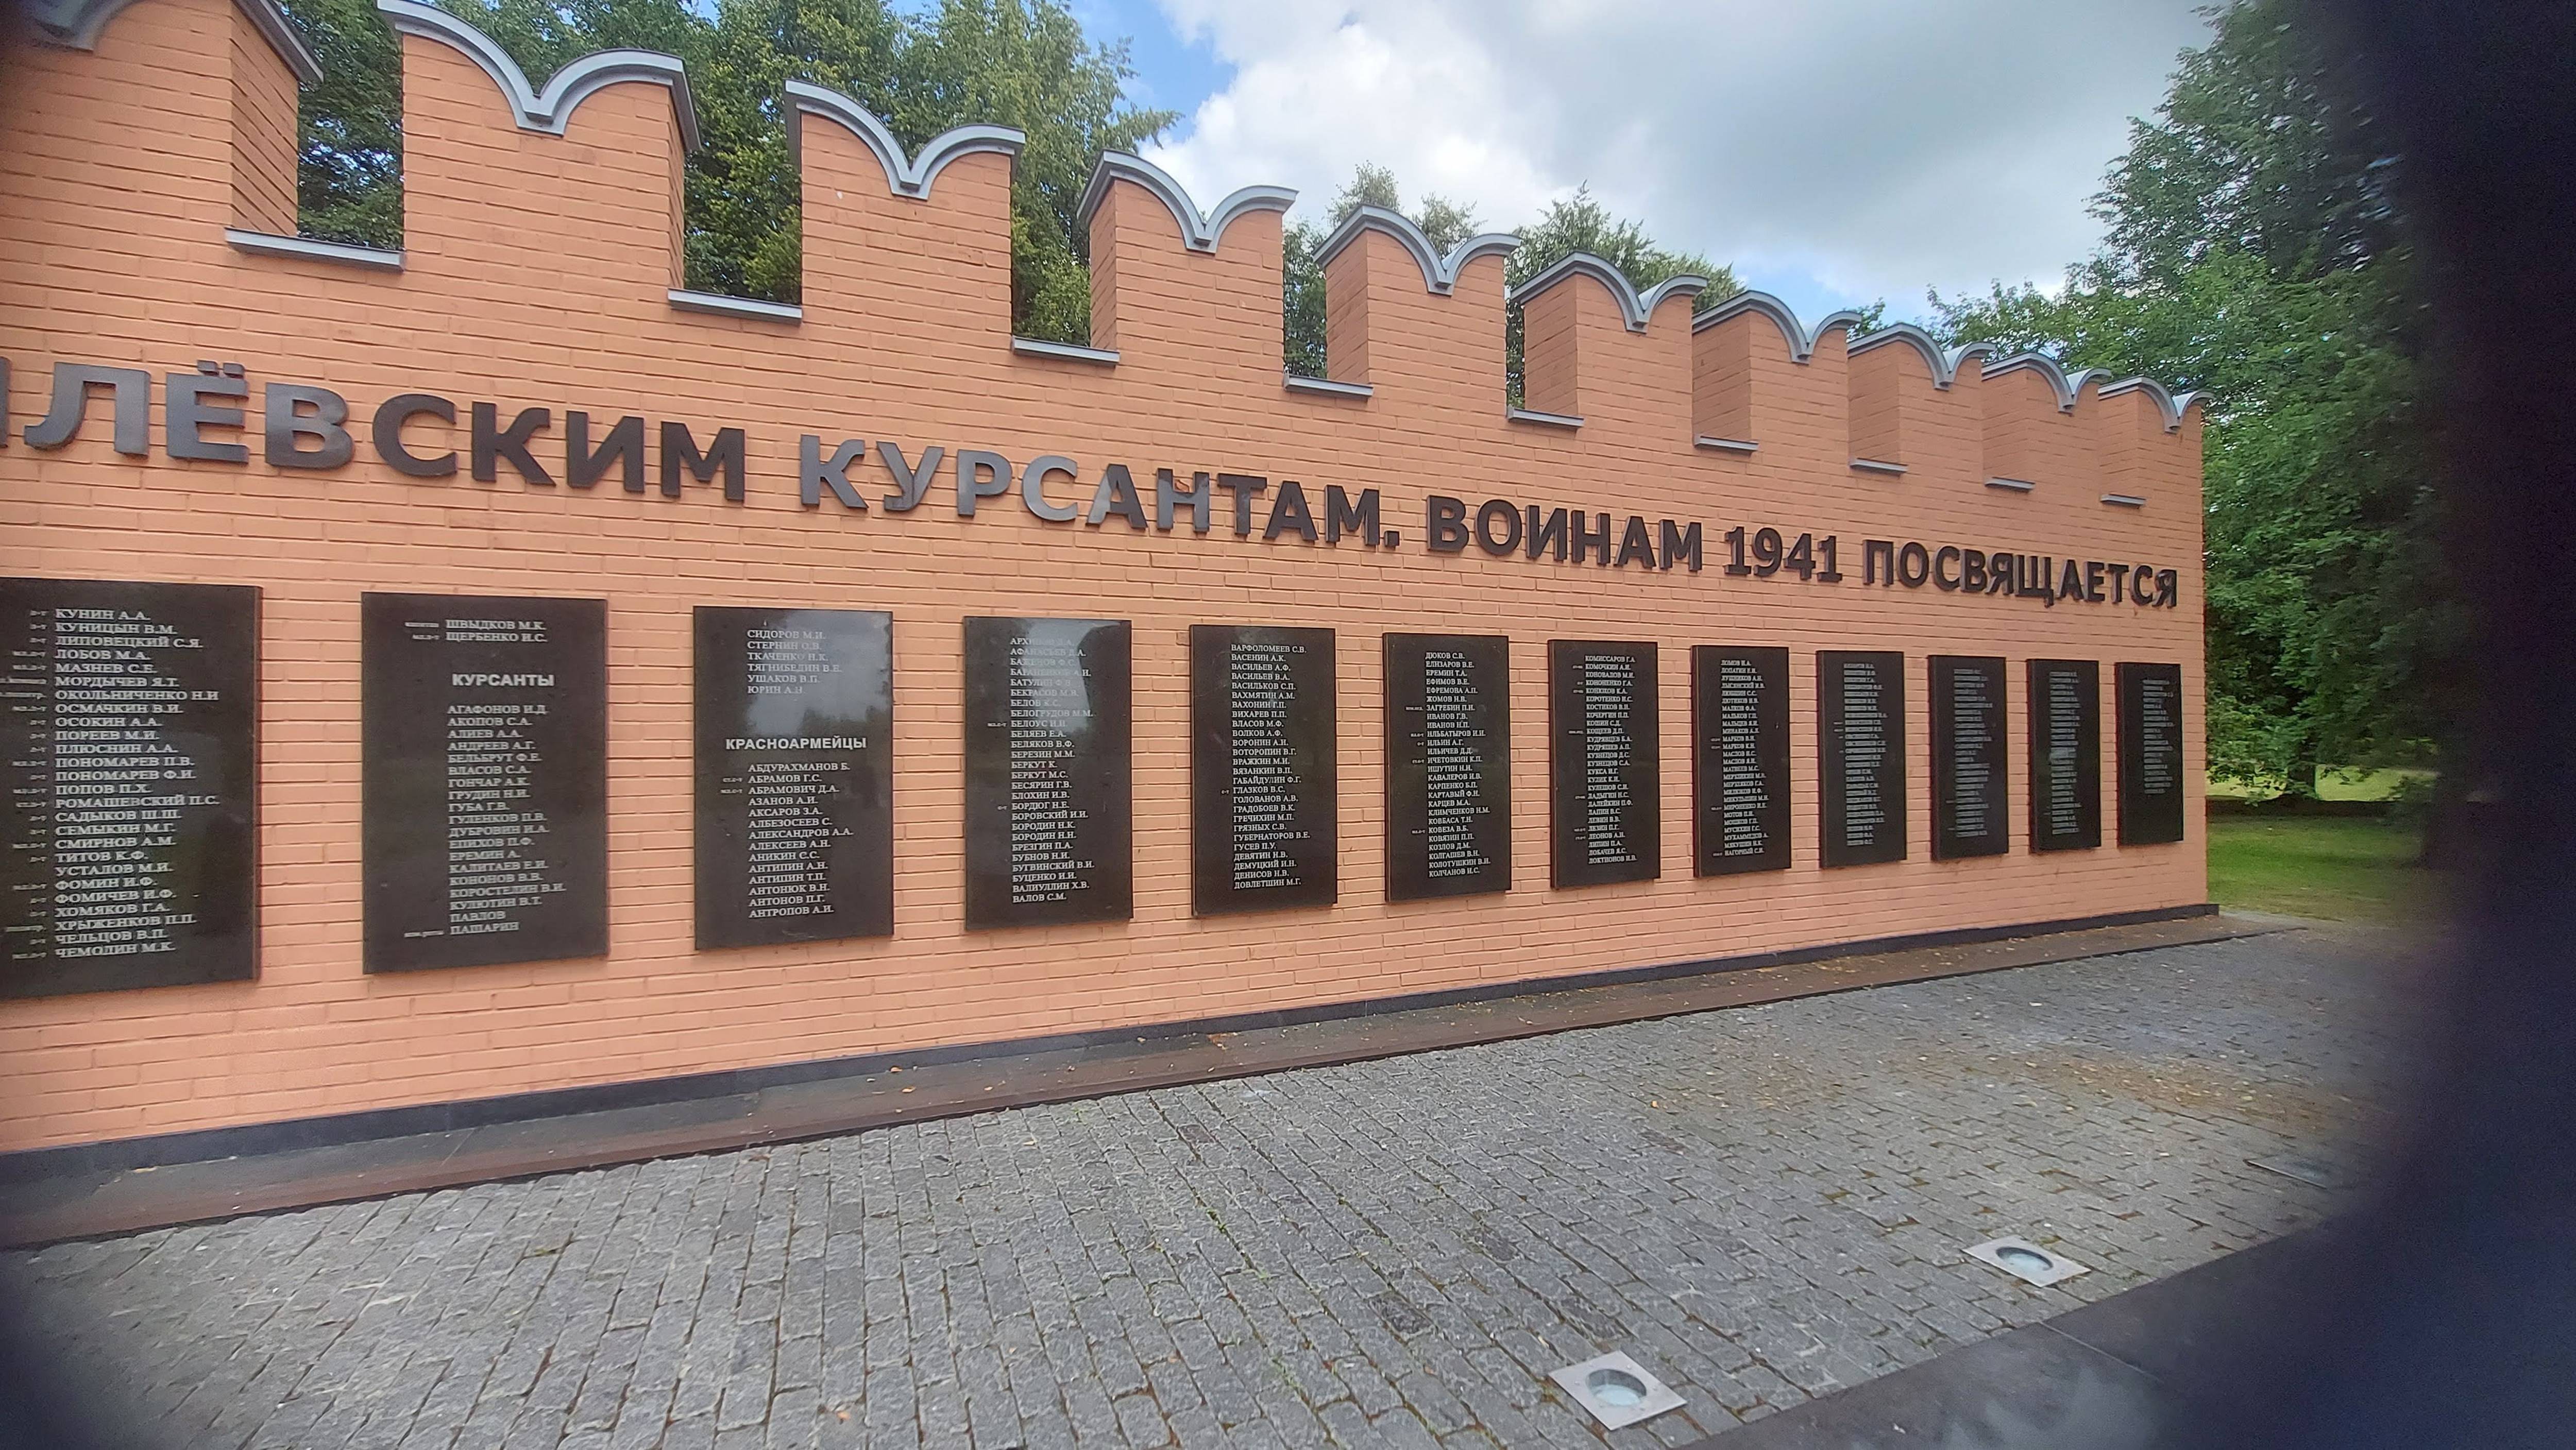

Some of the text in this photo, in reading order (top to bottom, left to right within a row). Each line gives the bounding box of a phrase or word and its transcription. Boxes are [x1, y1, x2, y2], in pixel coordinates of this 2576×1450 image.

[0, 355, 2179, 608] ЛЁВСКИМ КУРСАНТАМ. ВОИНАМ 1941 ПОСВЯЩАЕТСЯ
[453, 674, 554, 686] КУРСАНТЫ
[726, 736, 866, 749] КРАСНОАРМЕЙЦЫ
[748, 775, 800, 783] АБРАМОВ
[749, 786, 816, 794] АБРАМОВИЧ
[749, 797, 793, 806] АЗАНОВ
[749, 808, 800, 816] АКСАРОВ
[1233, 805, 1278, 813] ГРАДОБОЕВ
[749, 829, 829, 839] АЛЕКСАНДРОВ
[1234, 832, 1294, 841] ГУБЕРНАТОРОВ
[749, 841, 806, 850] АЛЕКСЕЕВ
[749, 852, 796, 861] АНИКИН
[1234, 871, 1272, 880] ДЕНИСОВ
[749, 885, 806, 895] АНТОНЮК
[749, 896, 803, 907] АНТОНОВ
[749, 907, 809, 917] АНТРОПОВ
